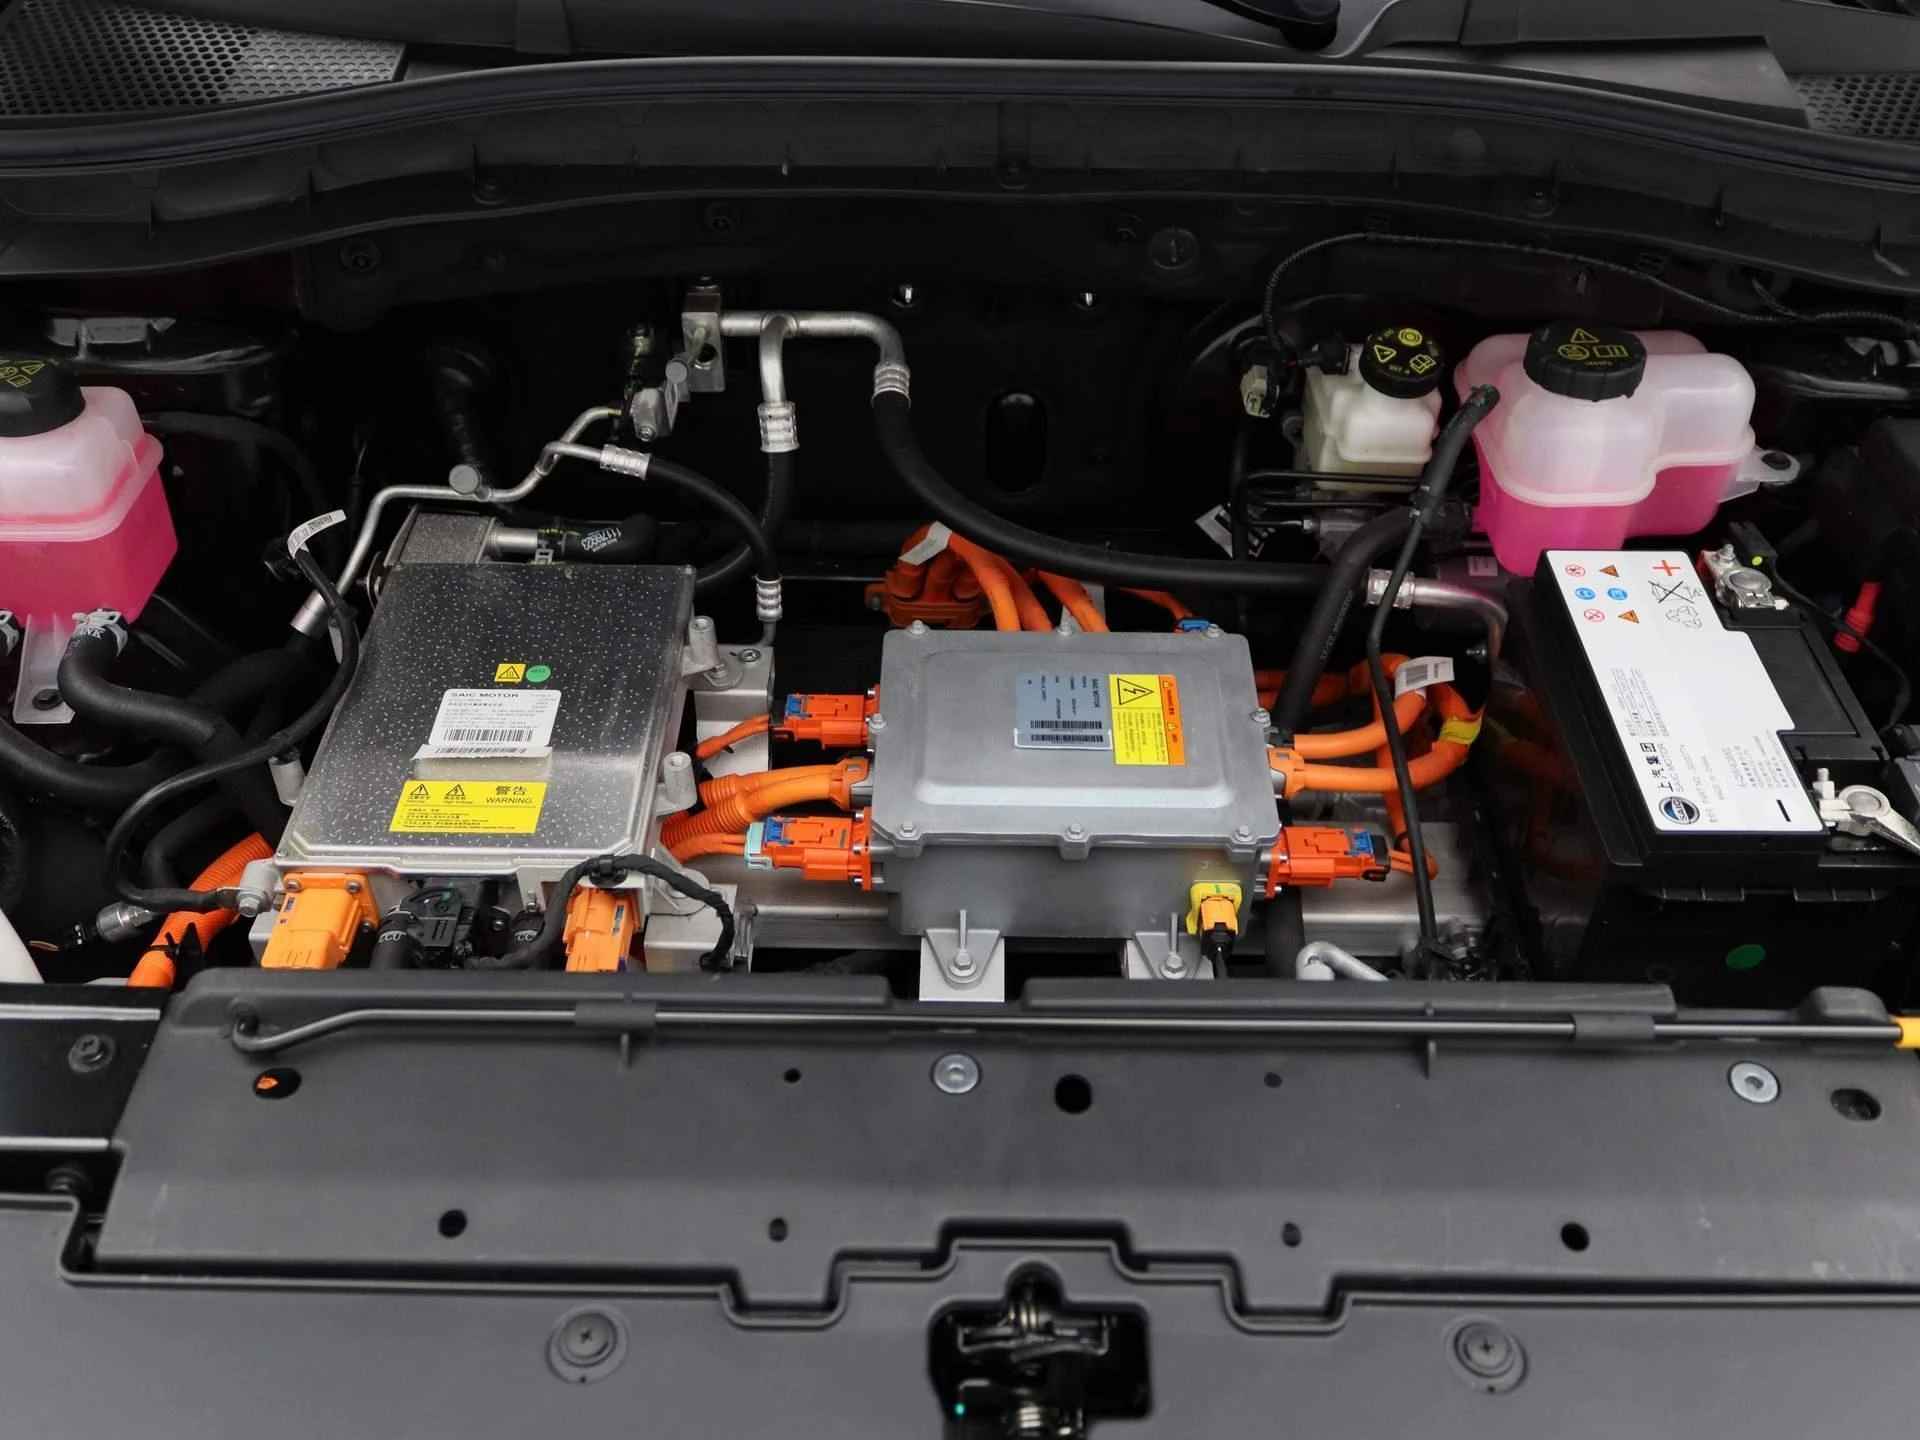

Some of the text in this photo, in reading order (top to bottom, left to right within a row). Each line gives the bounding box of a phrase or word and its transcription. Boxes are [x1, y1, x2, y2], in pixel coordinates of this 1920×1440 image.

[1640, 742, 1674, 792] 上汽集团
[1673, 798, 1688, 821] SAIC
